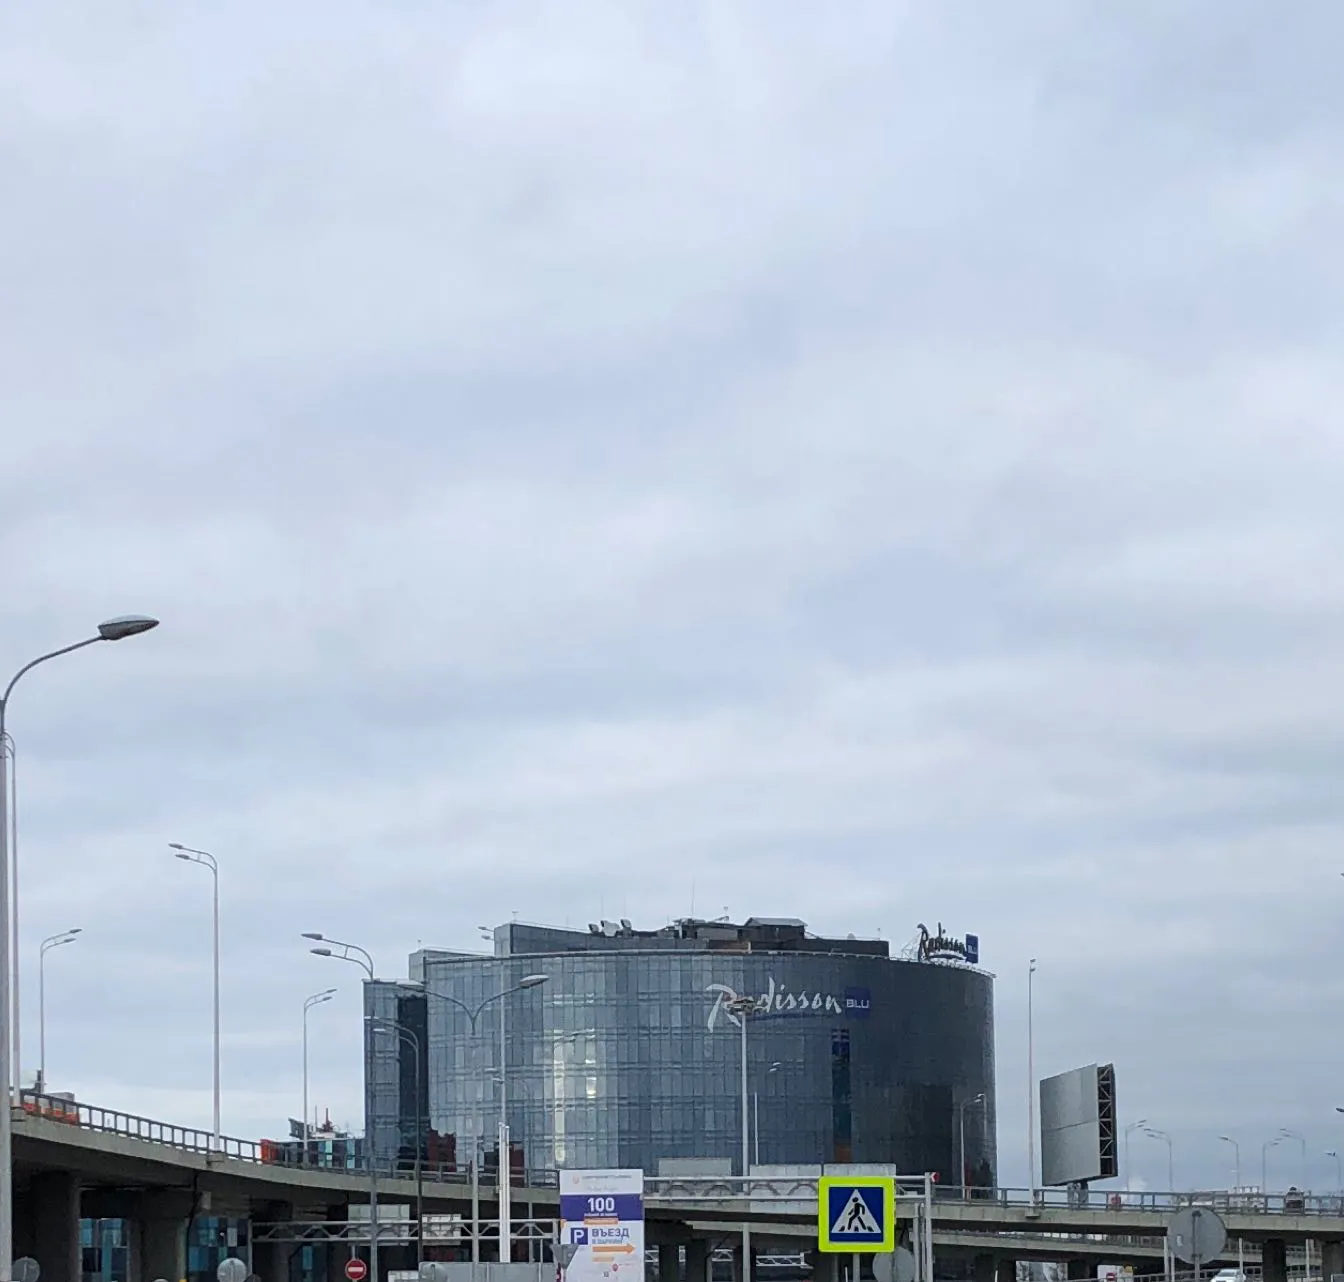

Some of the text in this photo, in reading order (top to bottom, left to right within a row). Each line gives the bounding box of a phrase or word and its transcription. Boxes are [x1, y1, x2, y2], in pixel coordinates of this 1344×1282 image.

[846, 999, 869, 1008] BLU
[587, 1197, 615, 1212] 100
[591, 1228, 630, 1238] ВЪЕЗД
